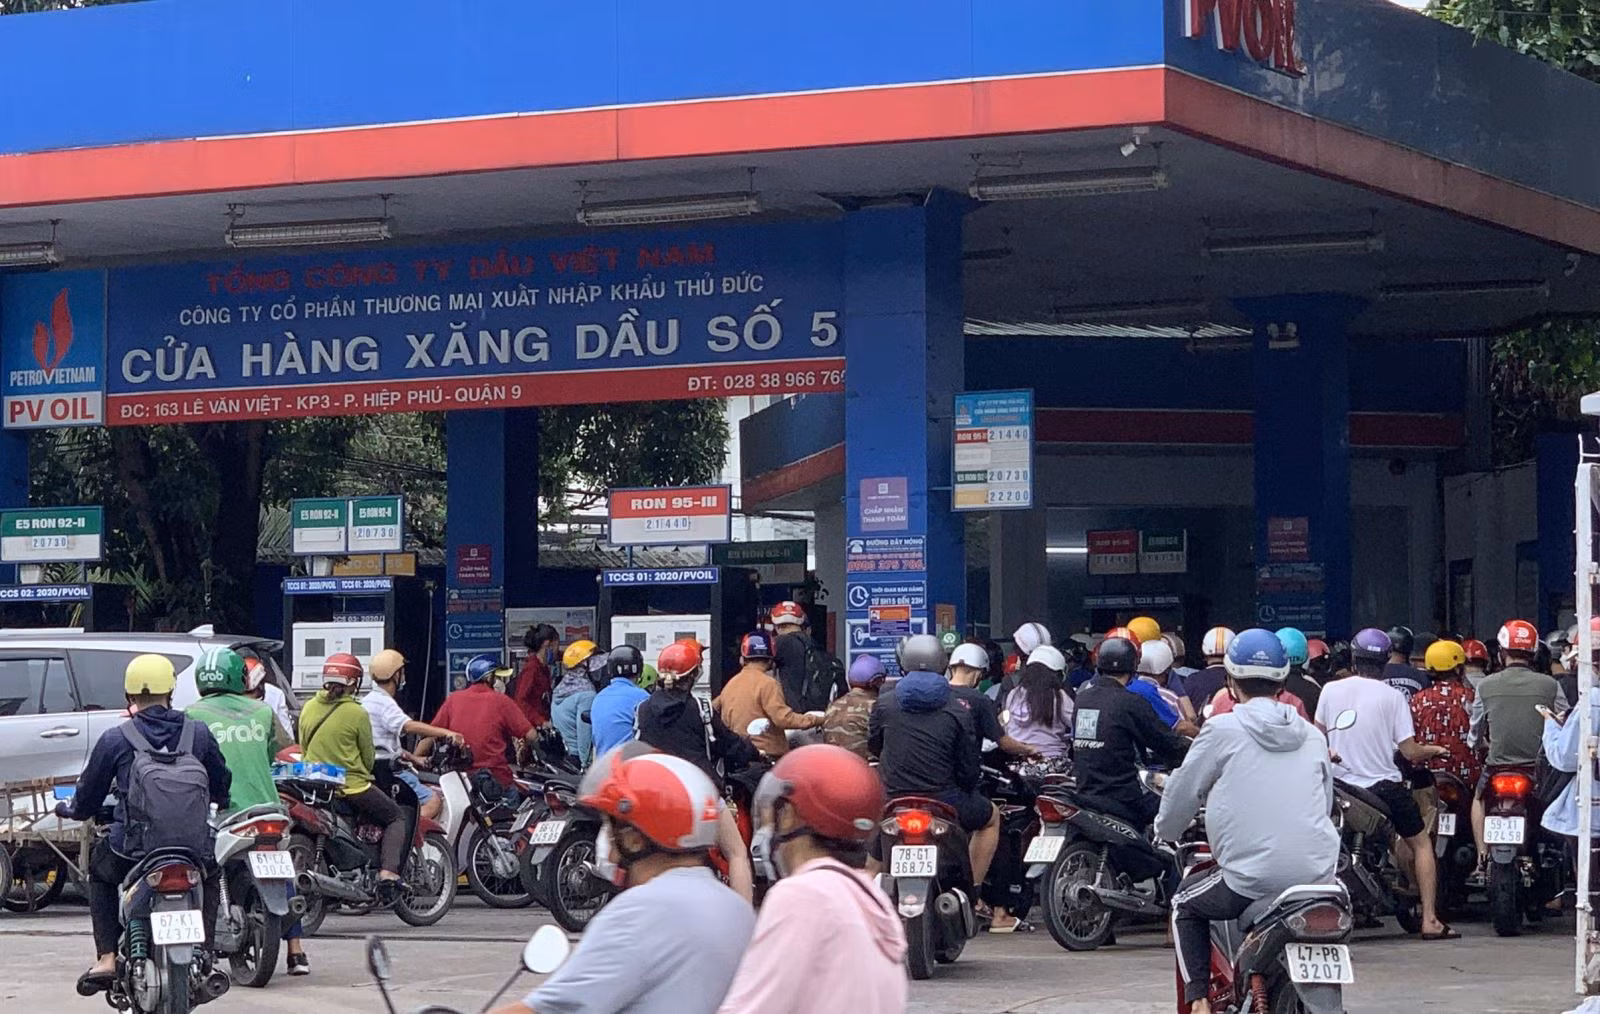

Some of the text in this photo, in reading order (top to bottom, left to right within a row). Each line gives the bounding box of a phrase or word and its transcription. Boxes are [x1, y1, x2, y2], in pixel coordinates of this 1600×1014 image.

[412, 257, 454, 281] TY
[638, 241, 715, 269] NAM
[180, 304, 230, 326] CÔNG
[240, 306, 262, 322] TY
[270, 294, 296, 320] CỔ
[364, 292, 441, 316] THƯƠNG
[448, 291, 484, 312] MẠI
[548, 282, 602, 306] NHẬP
[674, 272, 714, 298] THỦ
[722, 271, 764, 294] ĐỨC
[121, 298, 839, 384] CỬA HÀNG XĂNG DẦU SỐ 5
[10, 366, 96, 387] PETROVIETNAM
[688, 376, 717, 391] ĐT:
[724, 374, 755, 390] 028
[760, 373, 780, 388] 38
[786, 371, 816, 387] 966
[120, 404, 150, 418] ĐC:
[154, 402, 179, 417] 163
[184, 396, 204, 416] LÊ
[209, 394, 240, 414] VĂN
[244, 394, 282, 416] VIỆT
[296, 394, 330, 411] KP3
[344, 394, 358, 408] P.
[363, 388, 400, 410] HIỆP
[512, 385, 522, 399] 9
[10, 395, 95, 424] PV OIL
[990, 430, 1028, 440] 21440
[989, 470, 1028, 480] 20730
[990, 490, 1028, 501] 22200
[631, 496, 718, 510] RON 95-III
[16, 518, 86, 530] E5 RON 92-II
[646, 518, 688, 529] 21440
[358, 528, 394, 538] 20730
[33, 537, 66, 548] 20730
[608, 570, 714, 582] TCCS 01: 2020/PVOIL
[20, 589, 34, 598] 02:
[36, 588, 88, 598] 2020/PVOIL
[199, 671, 224, 682] Grab
[210, 718, 266, 744] Grab
[894, 861, 933, 874] 368.75
[1300, 963, 1342, 980] 3207
